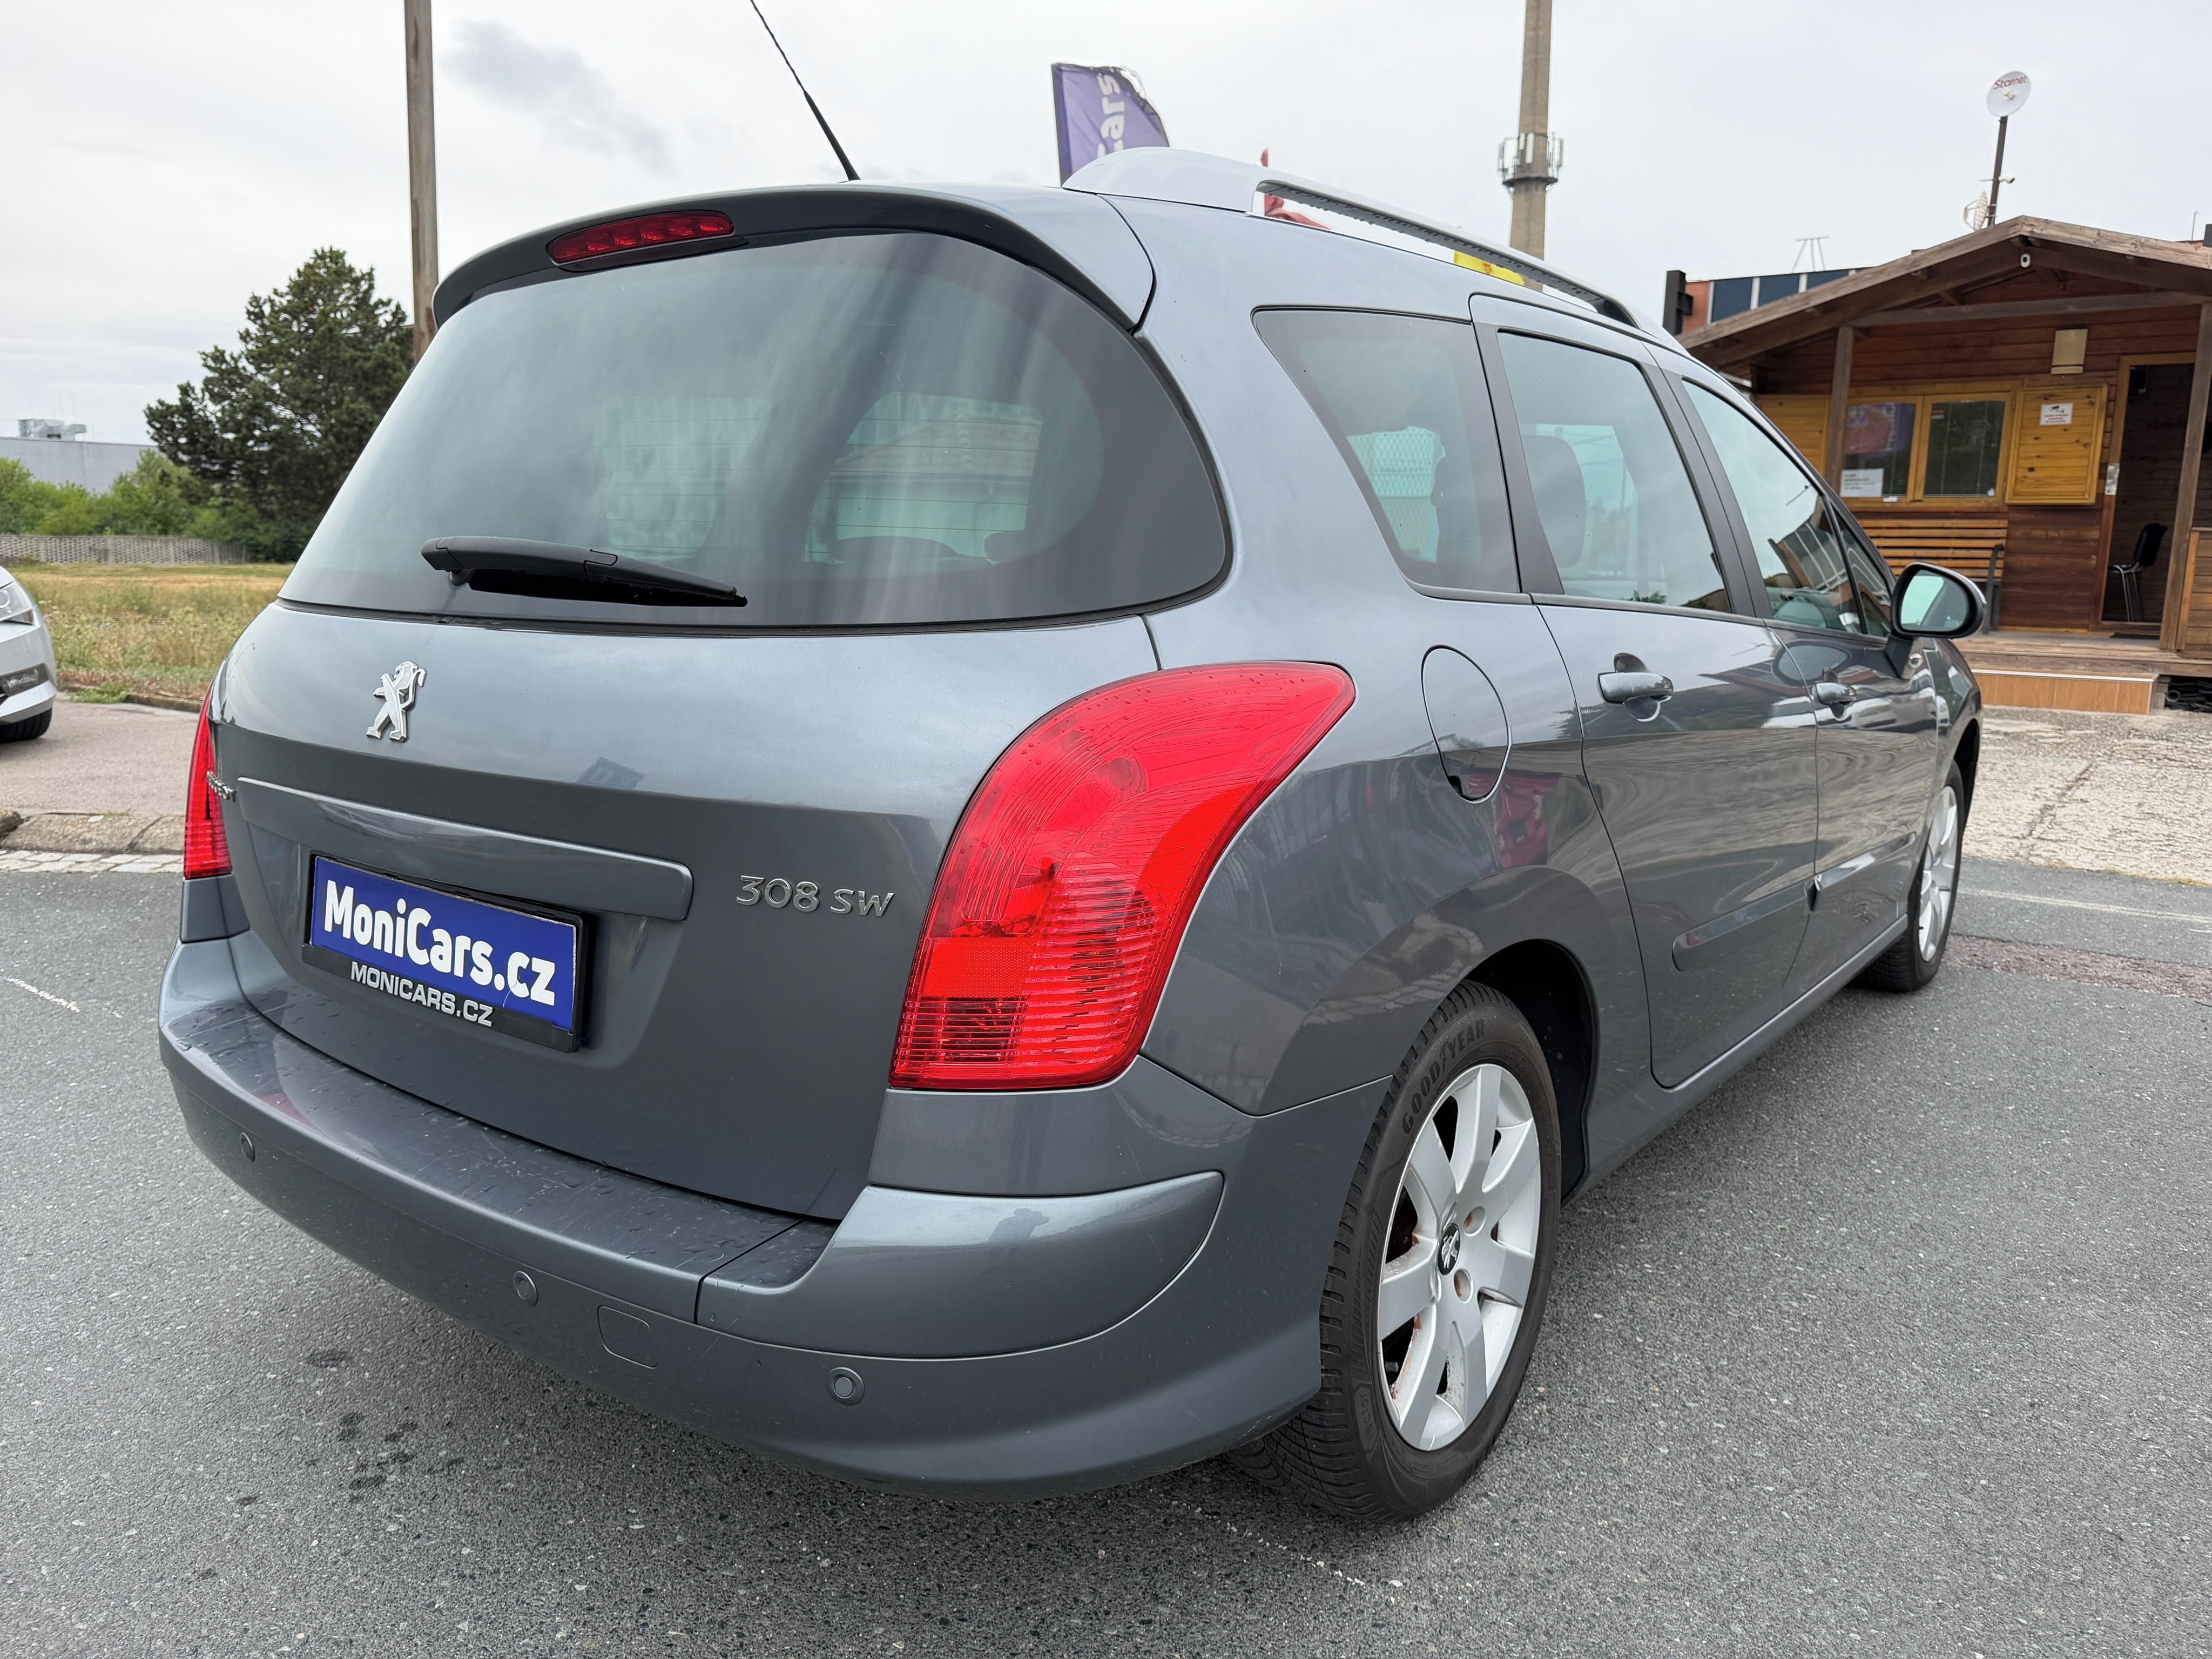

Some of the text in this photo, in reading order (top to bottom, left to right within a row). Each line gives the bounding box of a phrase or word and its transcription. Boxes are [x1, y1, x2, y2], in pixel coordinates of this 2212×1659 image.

[1097, 74, 1125, 158] ars
[736, 875, 895, 917] 308 SW
[324, 880, 556, 1007] MoniCars.cz
[350, 961, 494, 1028] MONICARS.CZ
